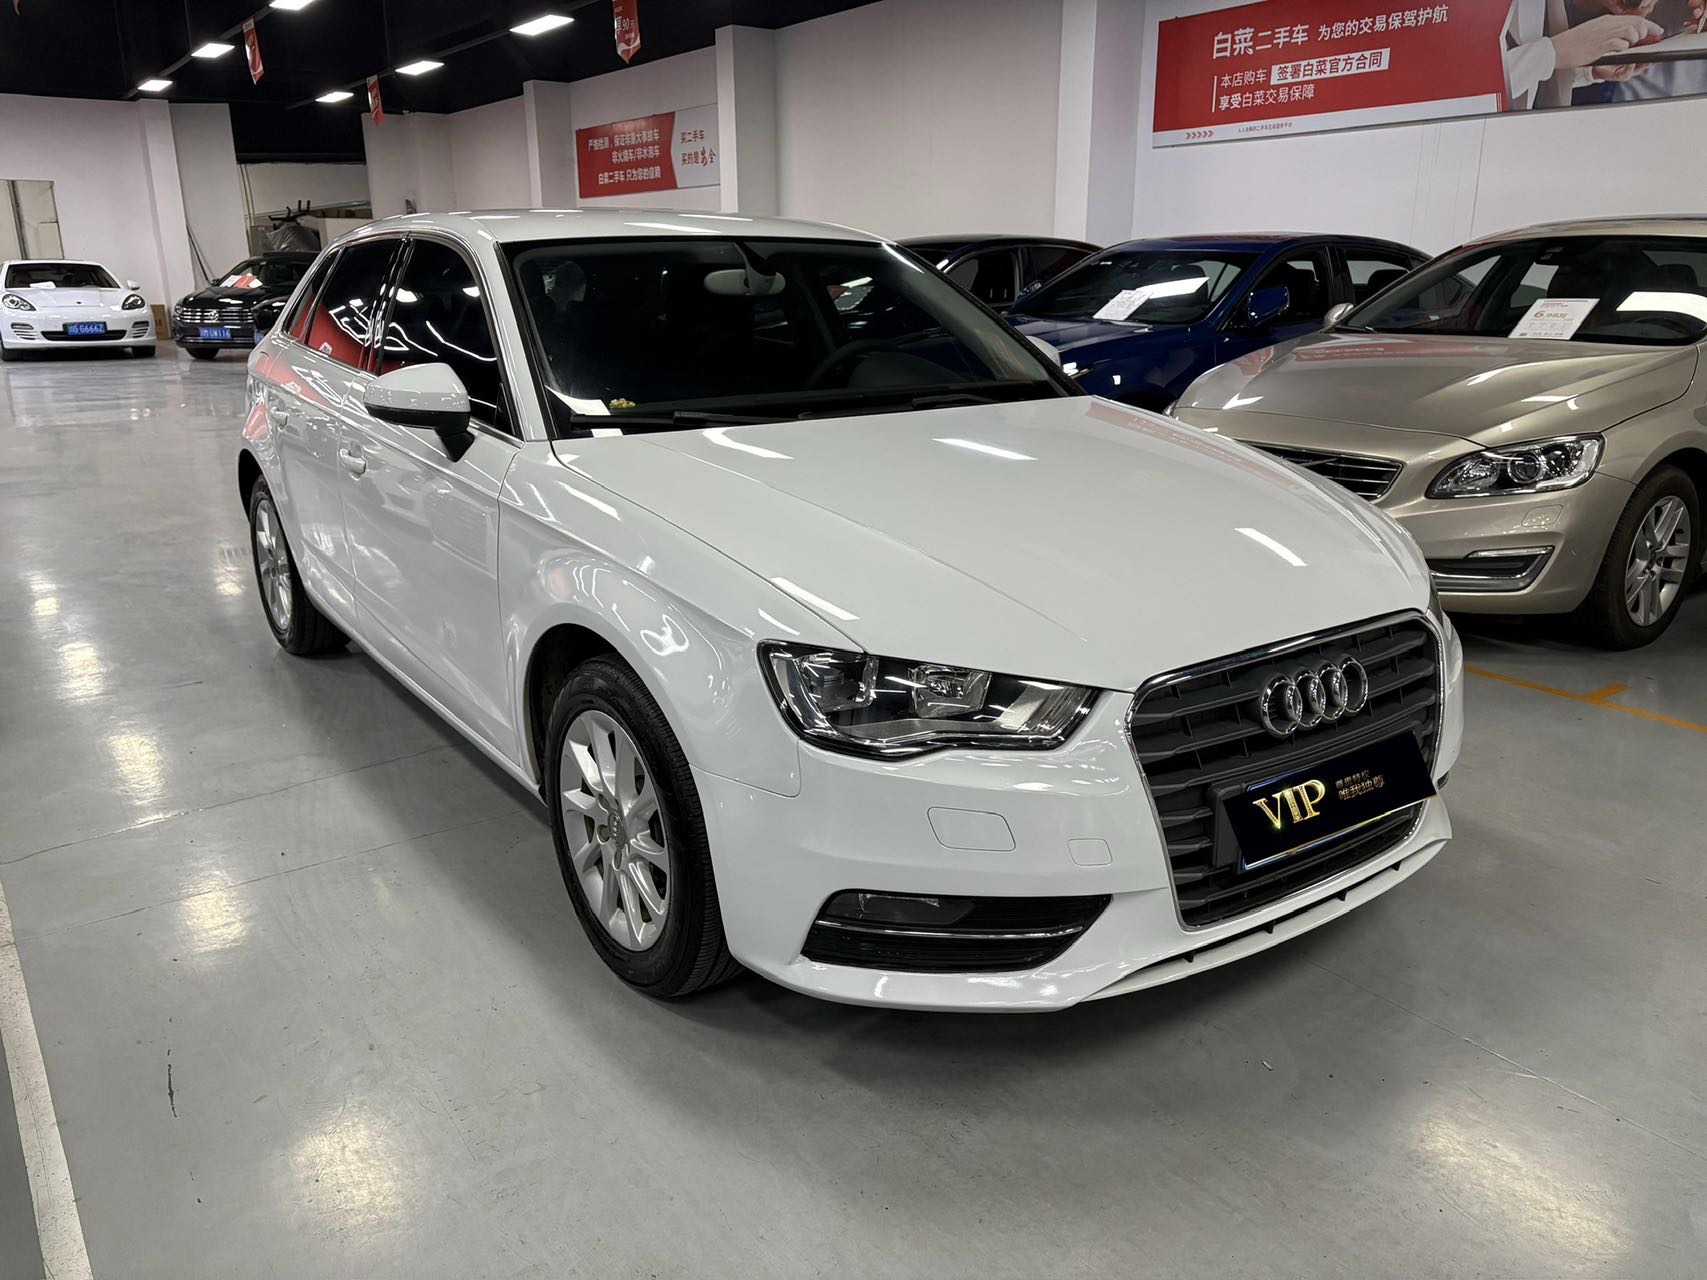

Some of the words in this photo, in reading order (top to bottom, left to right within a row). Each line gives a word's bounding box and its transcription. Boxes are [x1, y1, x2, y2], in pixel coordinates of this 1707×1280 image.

[1212, 24, 1310, 59] 白菜二手车
[1317, 4, 1449, 41] 为您的交易保驾护航
[1220, 68, 1268, 88] 本店购车
[1276, 51, 1383, 82] 签署白菜官方合同
[1218, 83, 1316, 111] 享受白菜交易保障
[680, 129, 705, 144] 买二手车
[598, 170, 625, 185] 白菜二手车
[1338, 774, 1385, 801] 唯我独尊
[1252, 779, 1326, 829] VIP
